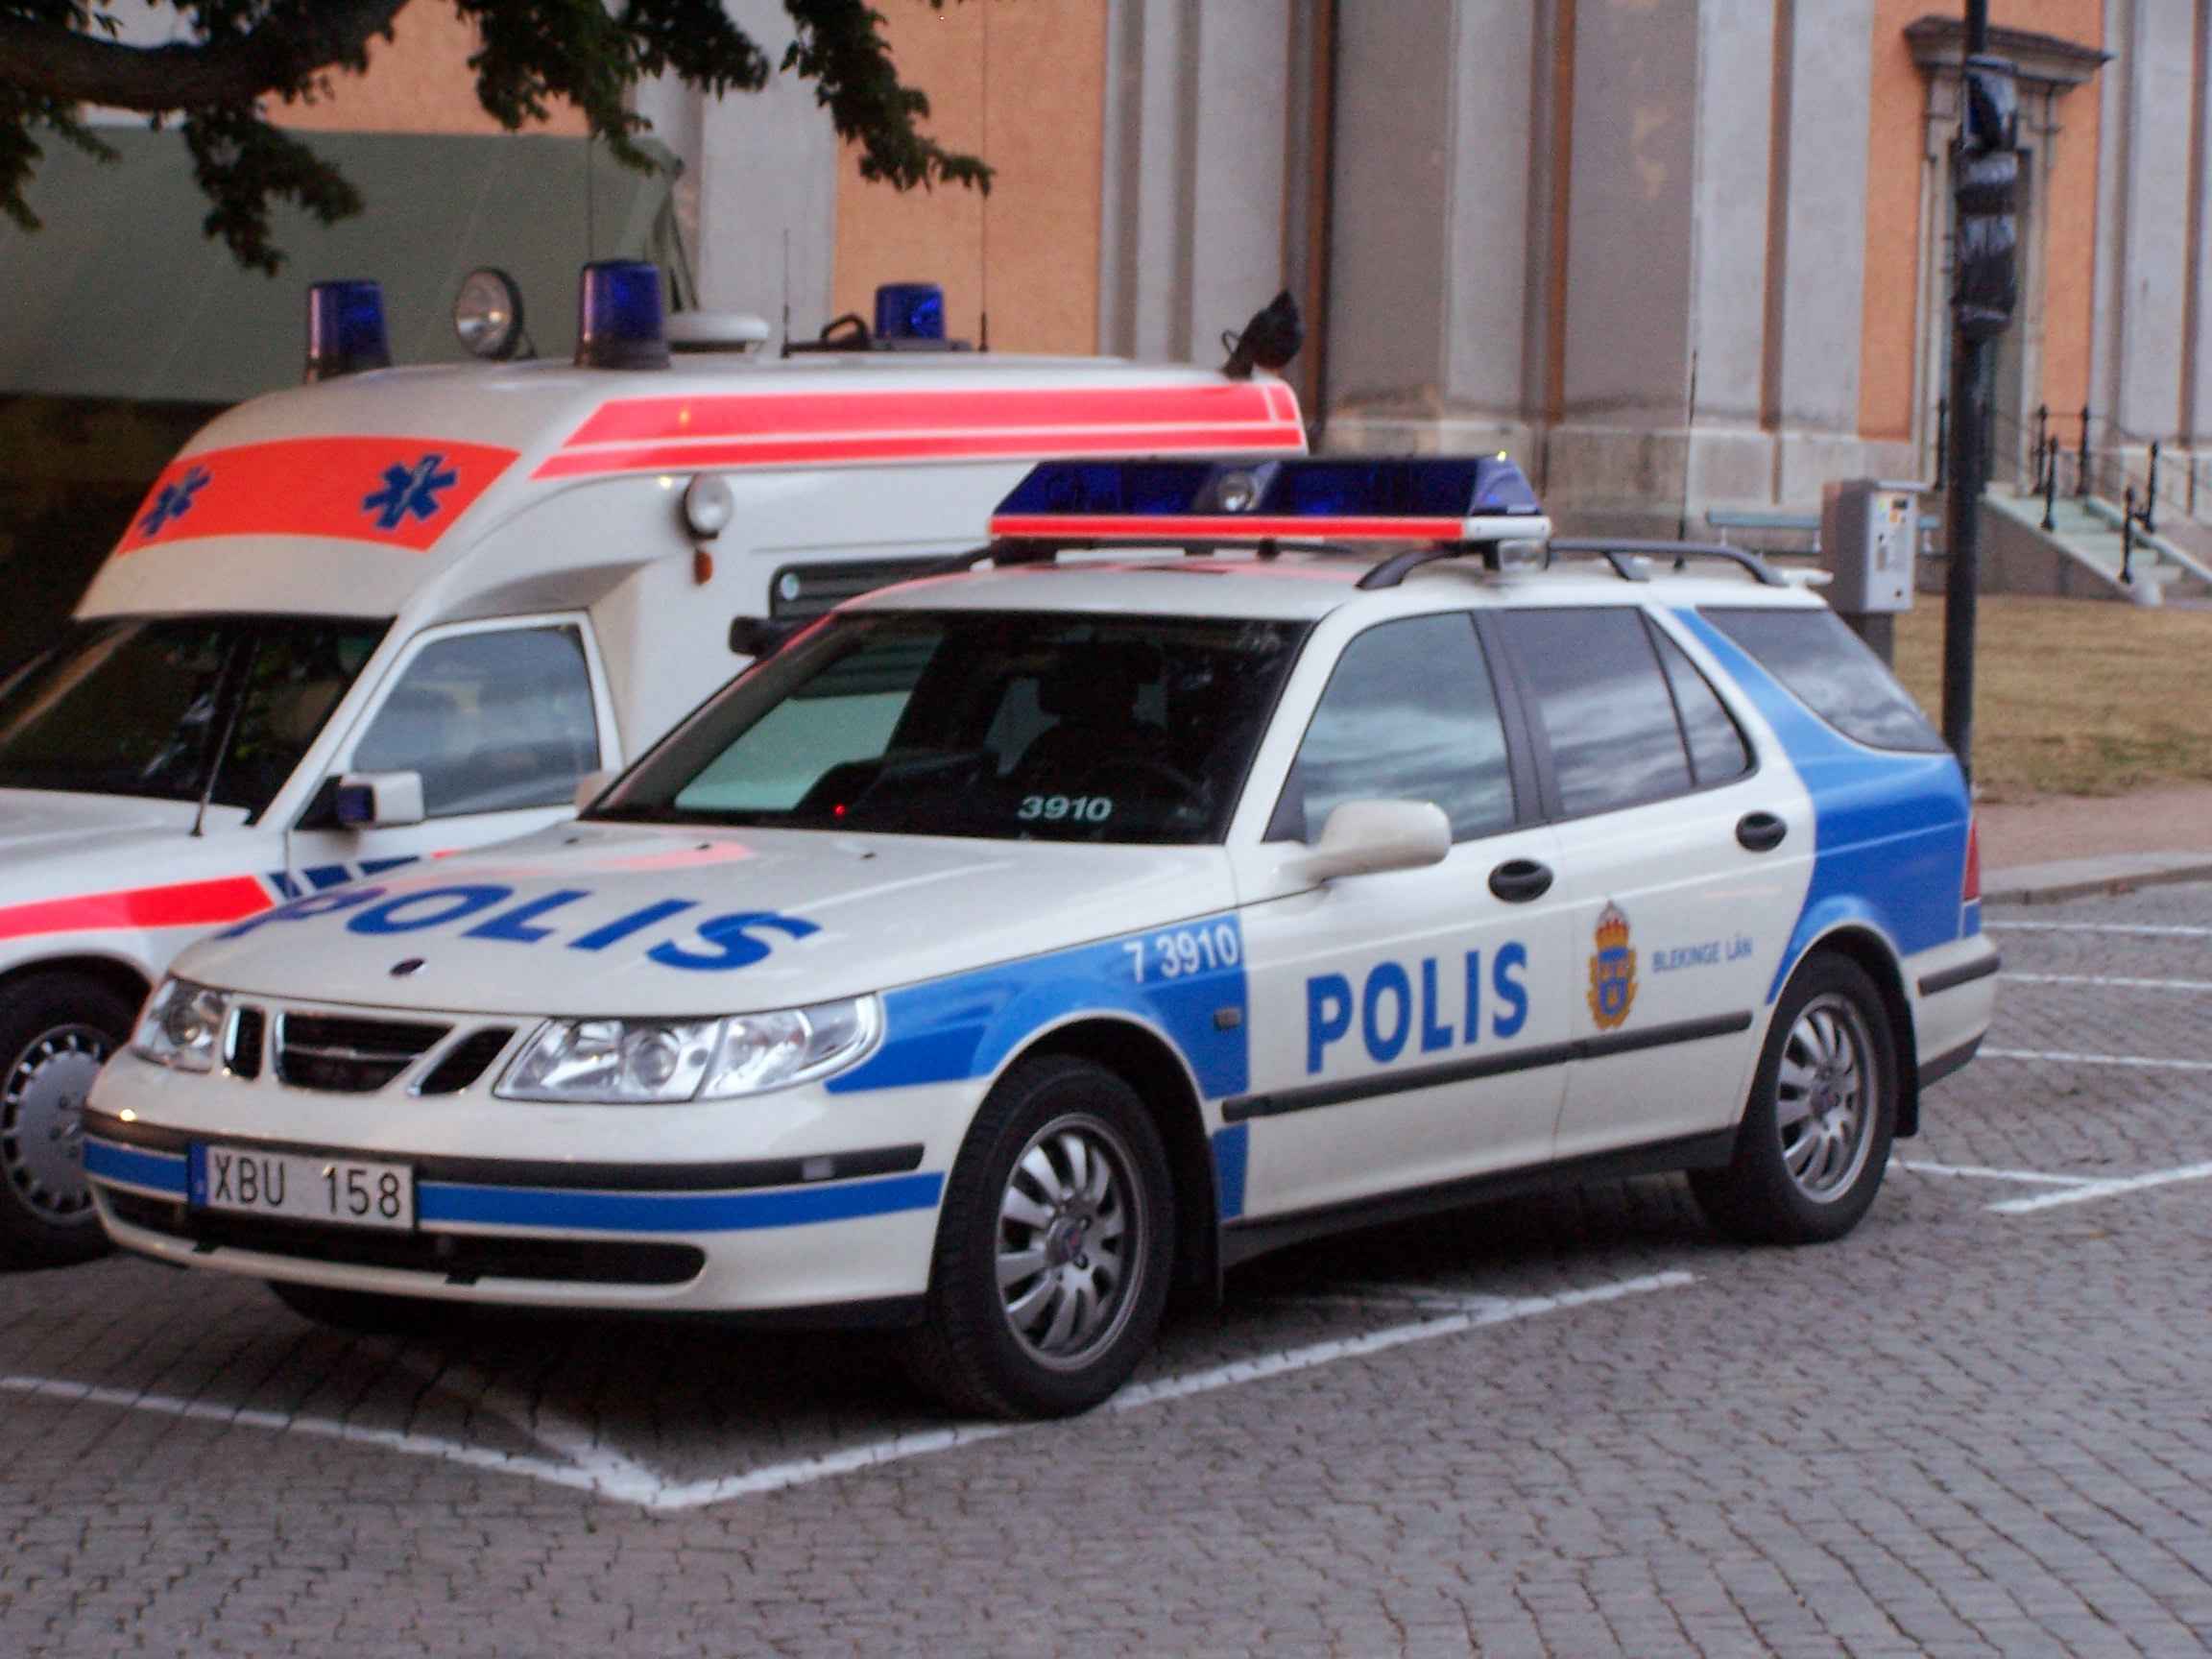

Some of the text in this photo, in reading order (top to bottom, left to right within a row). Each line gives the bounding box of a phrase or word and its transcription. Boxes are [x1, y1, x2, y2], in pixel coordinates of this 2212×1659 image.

[1018, 795, 1113, 821] 3910
[213, 884, 821, 973] POLIS
[1122, 924, 1238, 983] 7 3910
[1652, 941, 1721, 974] BLEKINGE
[1307, 940, 1528, 1075] POLIS
[214, 1153, 401, 1218] XBU 158
